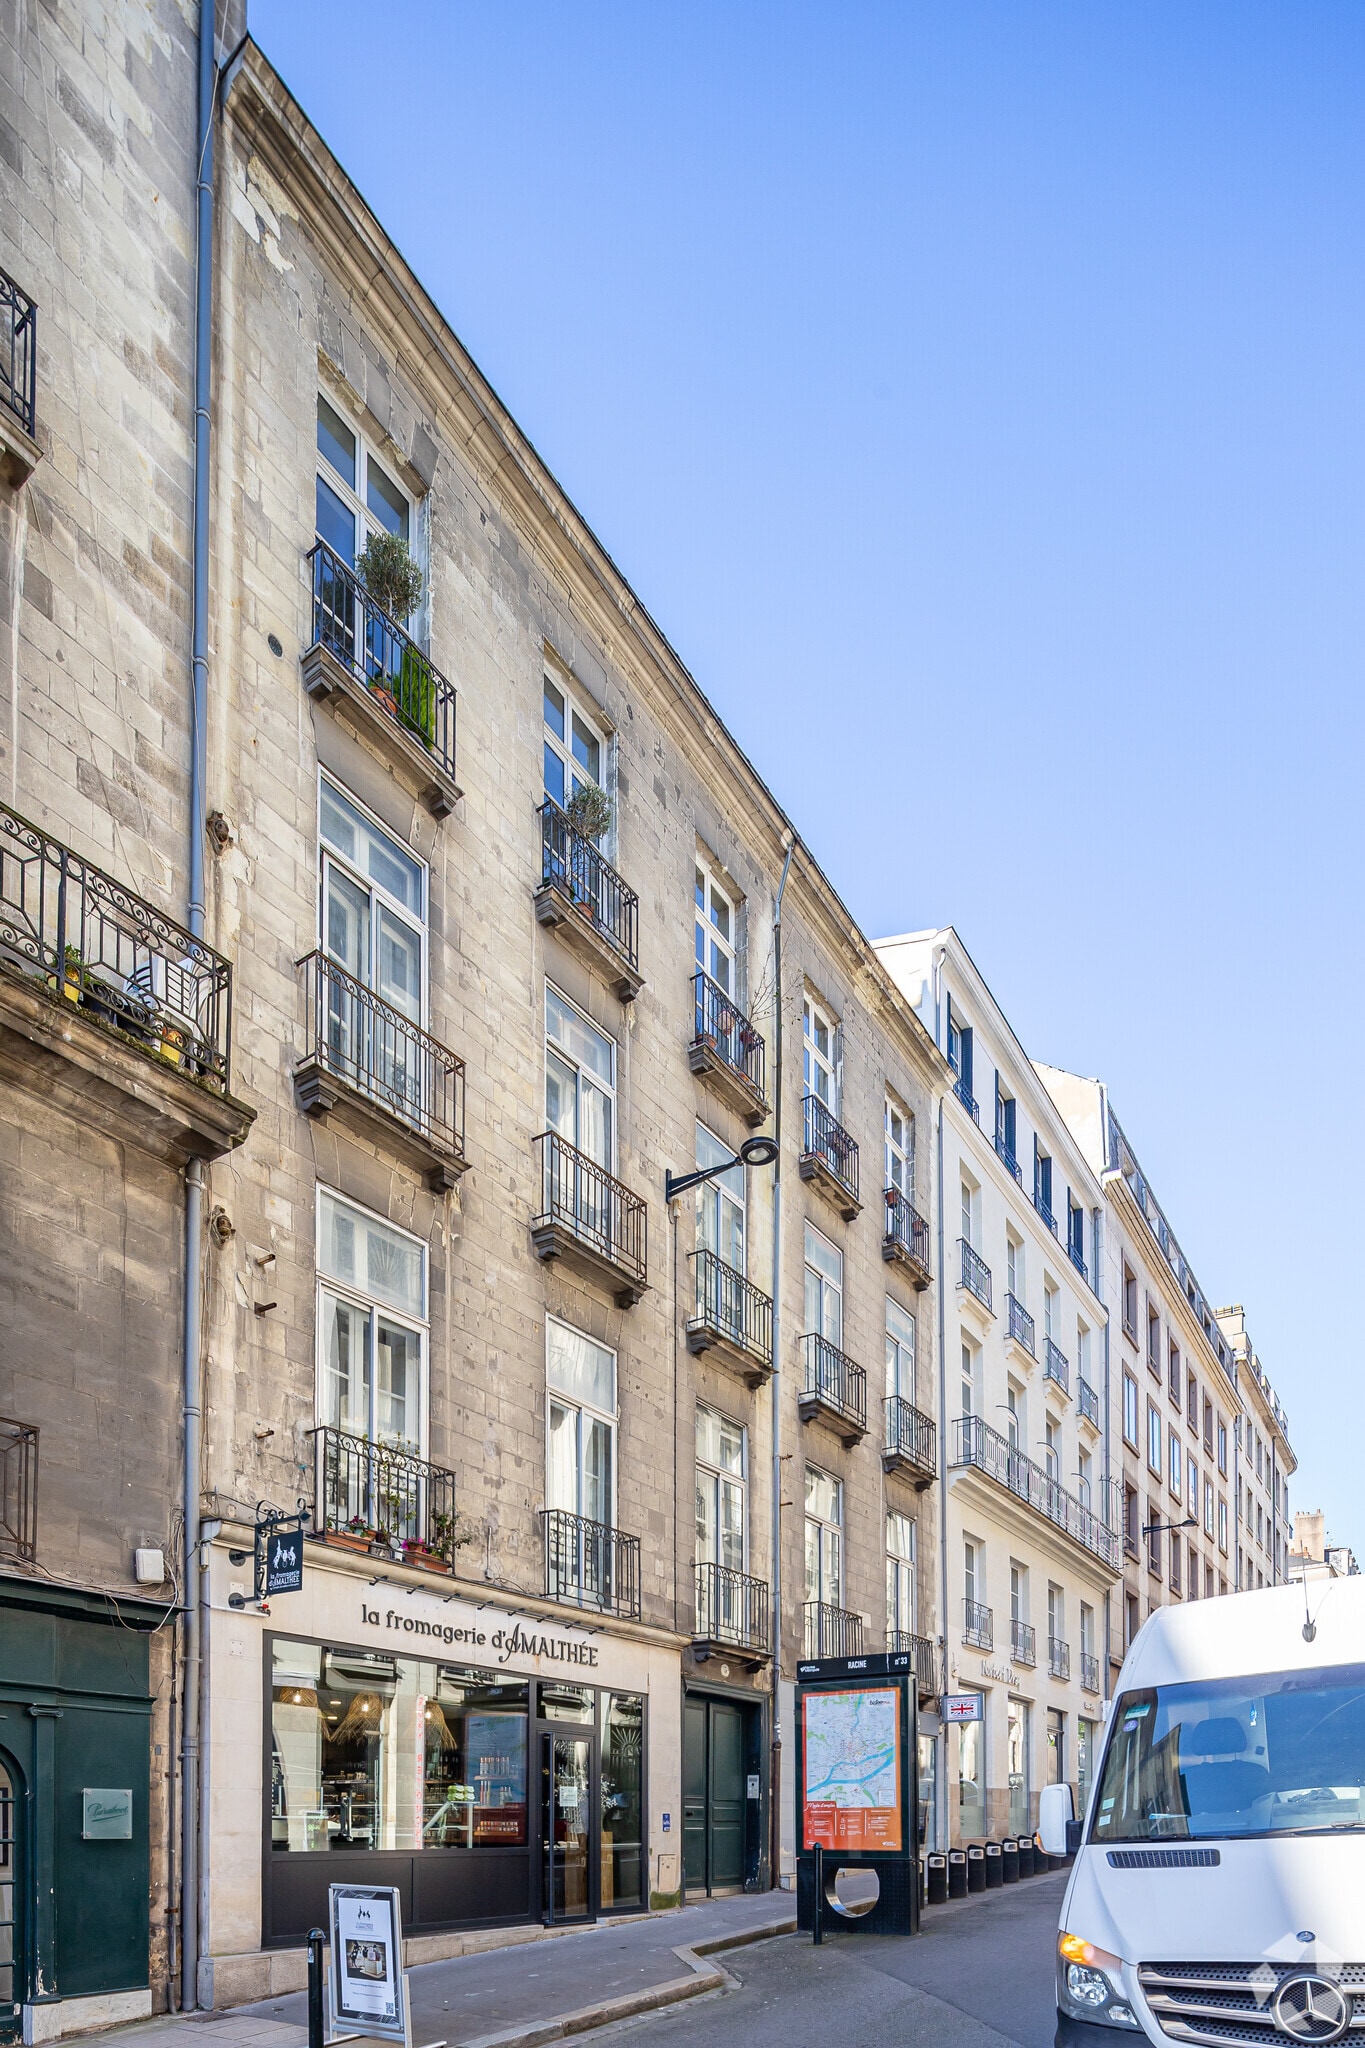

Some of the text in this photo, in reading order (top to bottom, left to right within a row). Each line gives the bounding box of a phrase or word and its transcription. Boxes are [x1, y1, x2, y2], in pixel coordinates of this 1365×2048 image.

[362, 1604, 598, 1667] la fromagerie d'AMALTHÉE
[847, 1660, 867, 1669] RACINE
